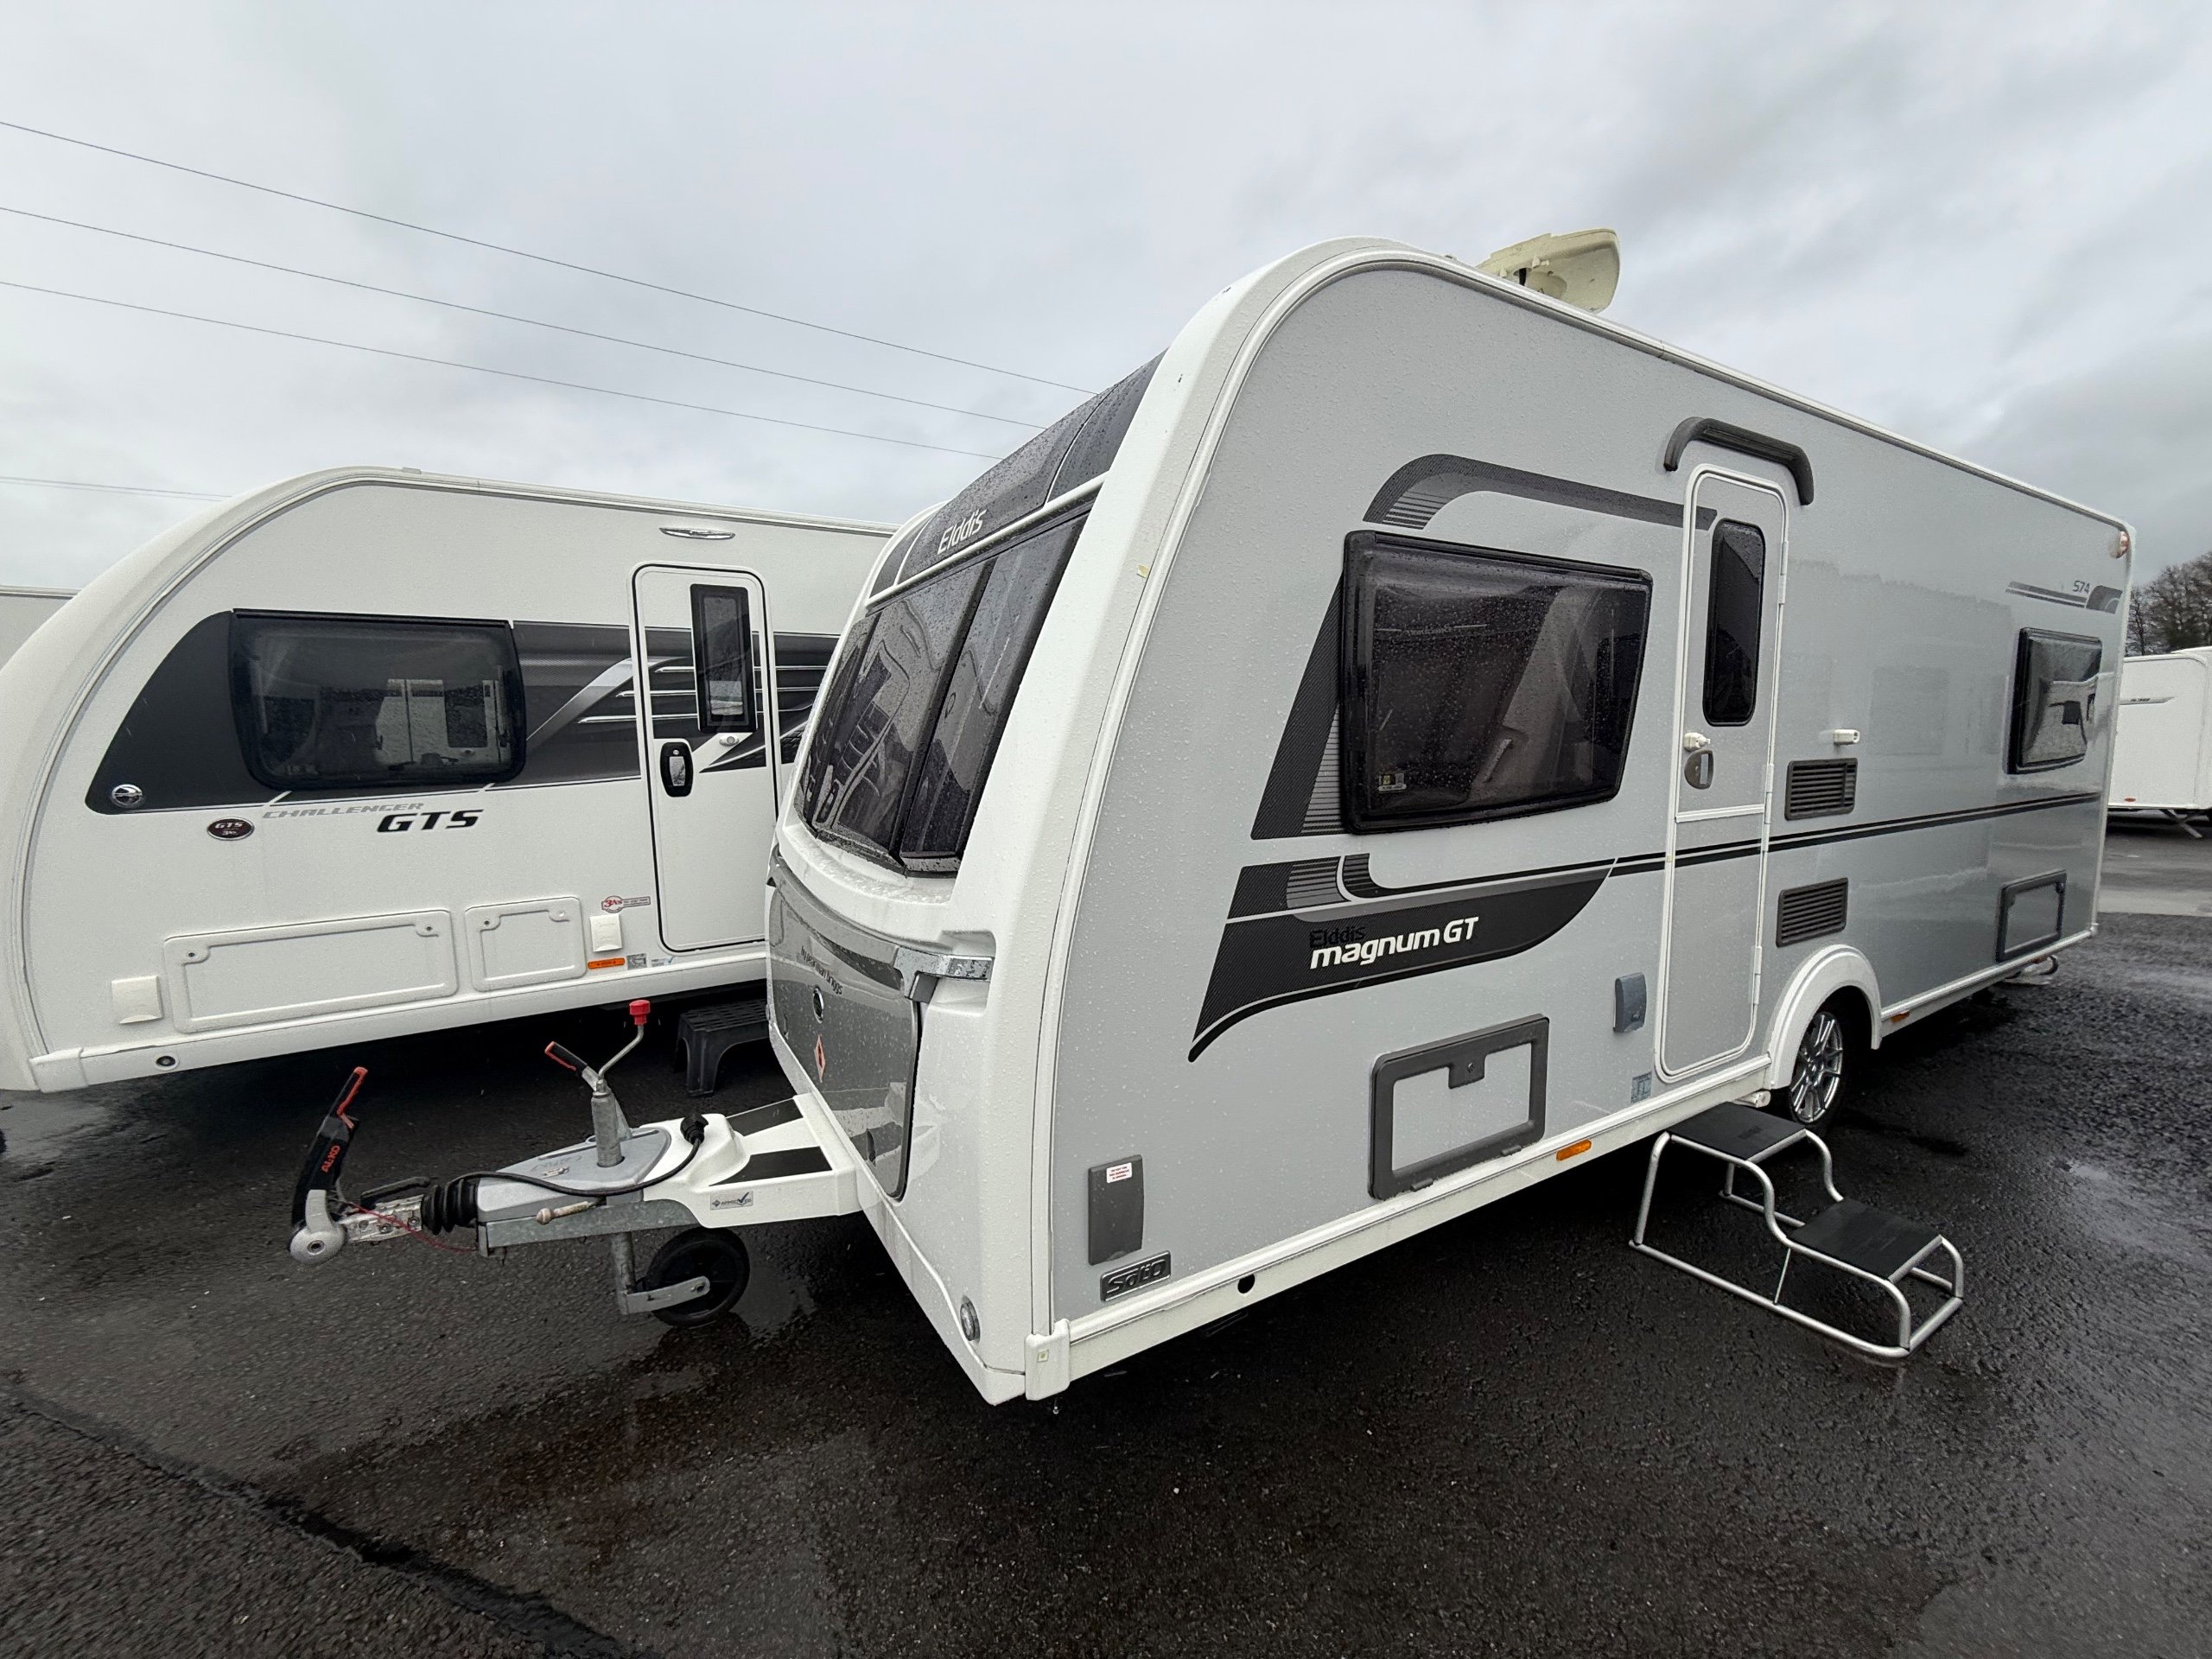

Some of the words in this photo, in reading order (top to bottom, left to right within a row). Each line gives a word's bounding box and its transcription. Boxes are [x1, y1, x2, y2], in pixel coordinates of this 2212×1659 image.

[937, 508, 988, 556] Elddis
[2073, 580, 2091, 594] 574
[263, 802, 425, 819] CHALLENGER
[377, 809, 484, 833] GTS
[1309, 925, 1367, 949] Elddis
[1310, 928, 1440, 969] magnum
[1443, 916, 1479, 944] GT
